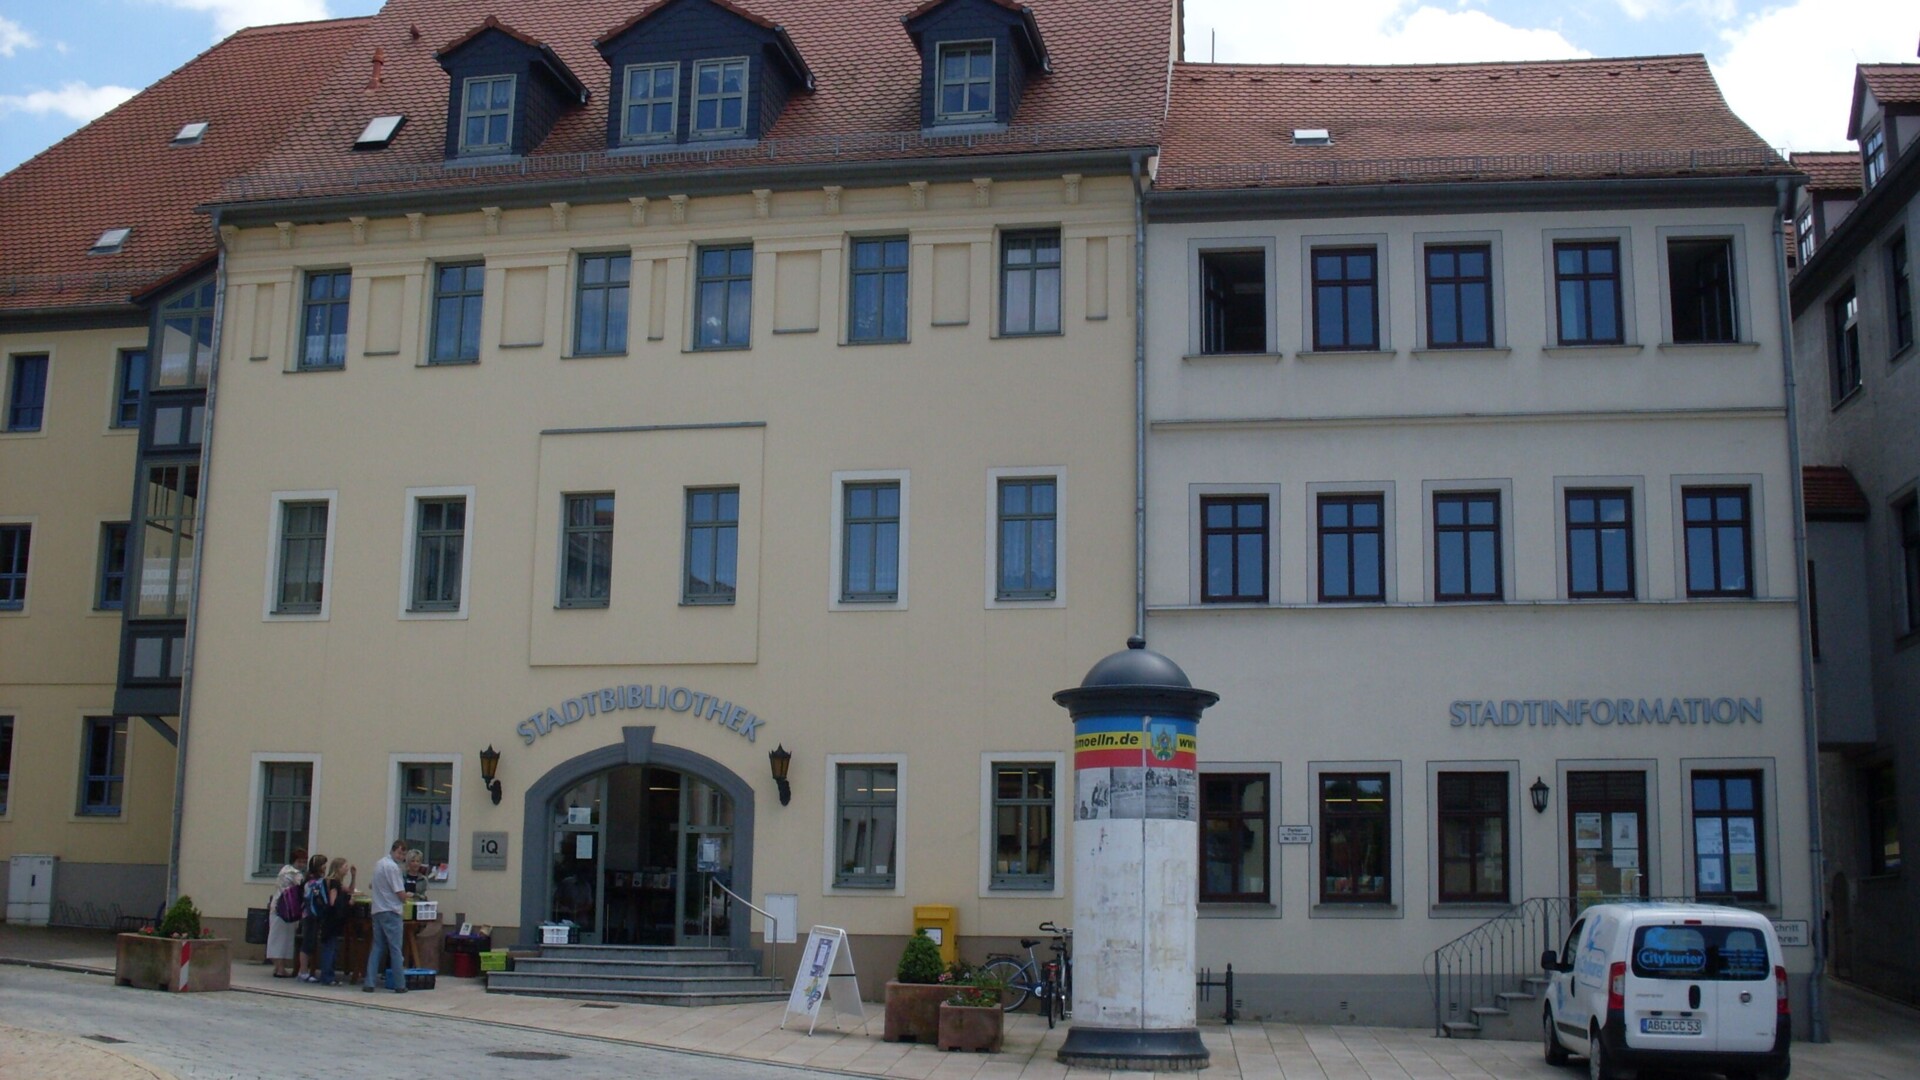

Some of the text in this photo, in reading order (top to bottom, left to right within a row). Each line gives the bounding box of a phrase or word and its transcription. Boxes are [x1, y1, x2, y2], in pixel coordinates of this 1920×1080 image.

[516, 684, 766, 746] STADTBIBLIOTHEK
[1449, 697, 1763, 727] STADTINFORMATION
[481, 839, 498, 855] iQ
[1641, 952, 1703, 967] Citykurier
[1648, 1020, 1699, 1031] ABG CC 53
